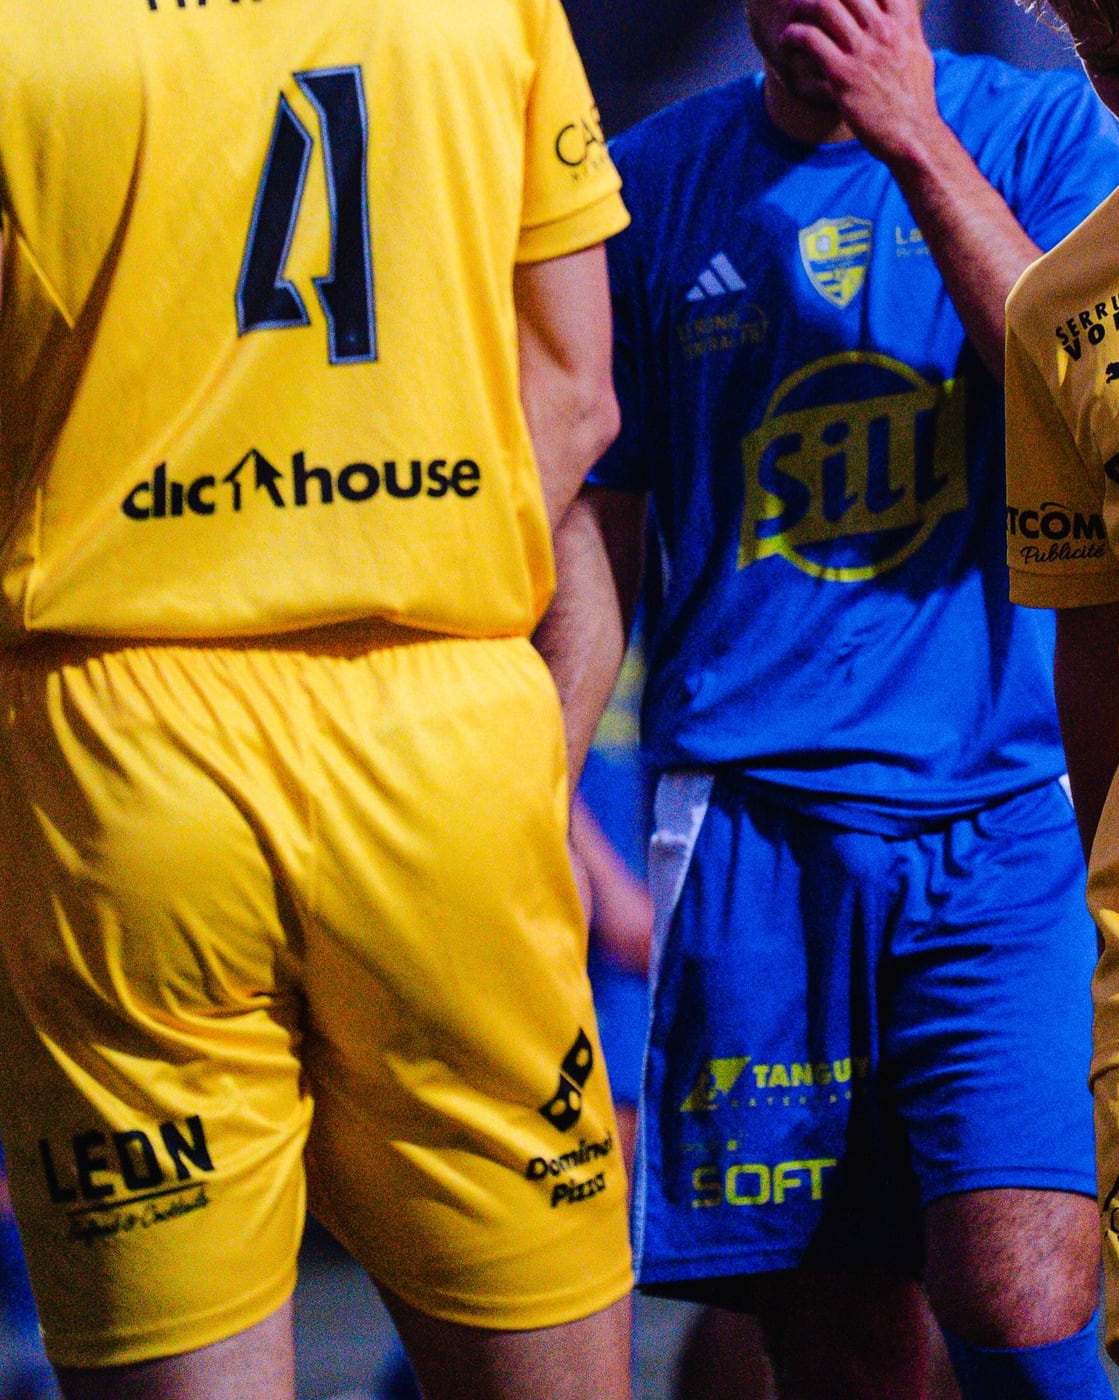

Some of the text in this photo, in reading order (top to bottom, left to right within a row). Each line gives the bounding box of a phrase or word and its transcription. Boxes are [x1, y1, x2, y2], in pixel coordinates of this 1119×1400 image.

[234, 64, 379, 366] 4
[291, 450, 481, 507] house
[38, 1114, 215, 1203] LEON
[691, 1157, 838, 1208] SOFT
